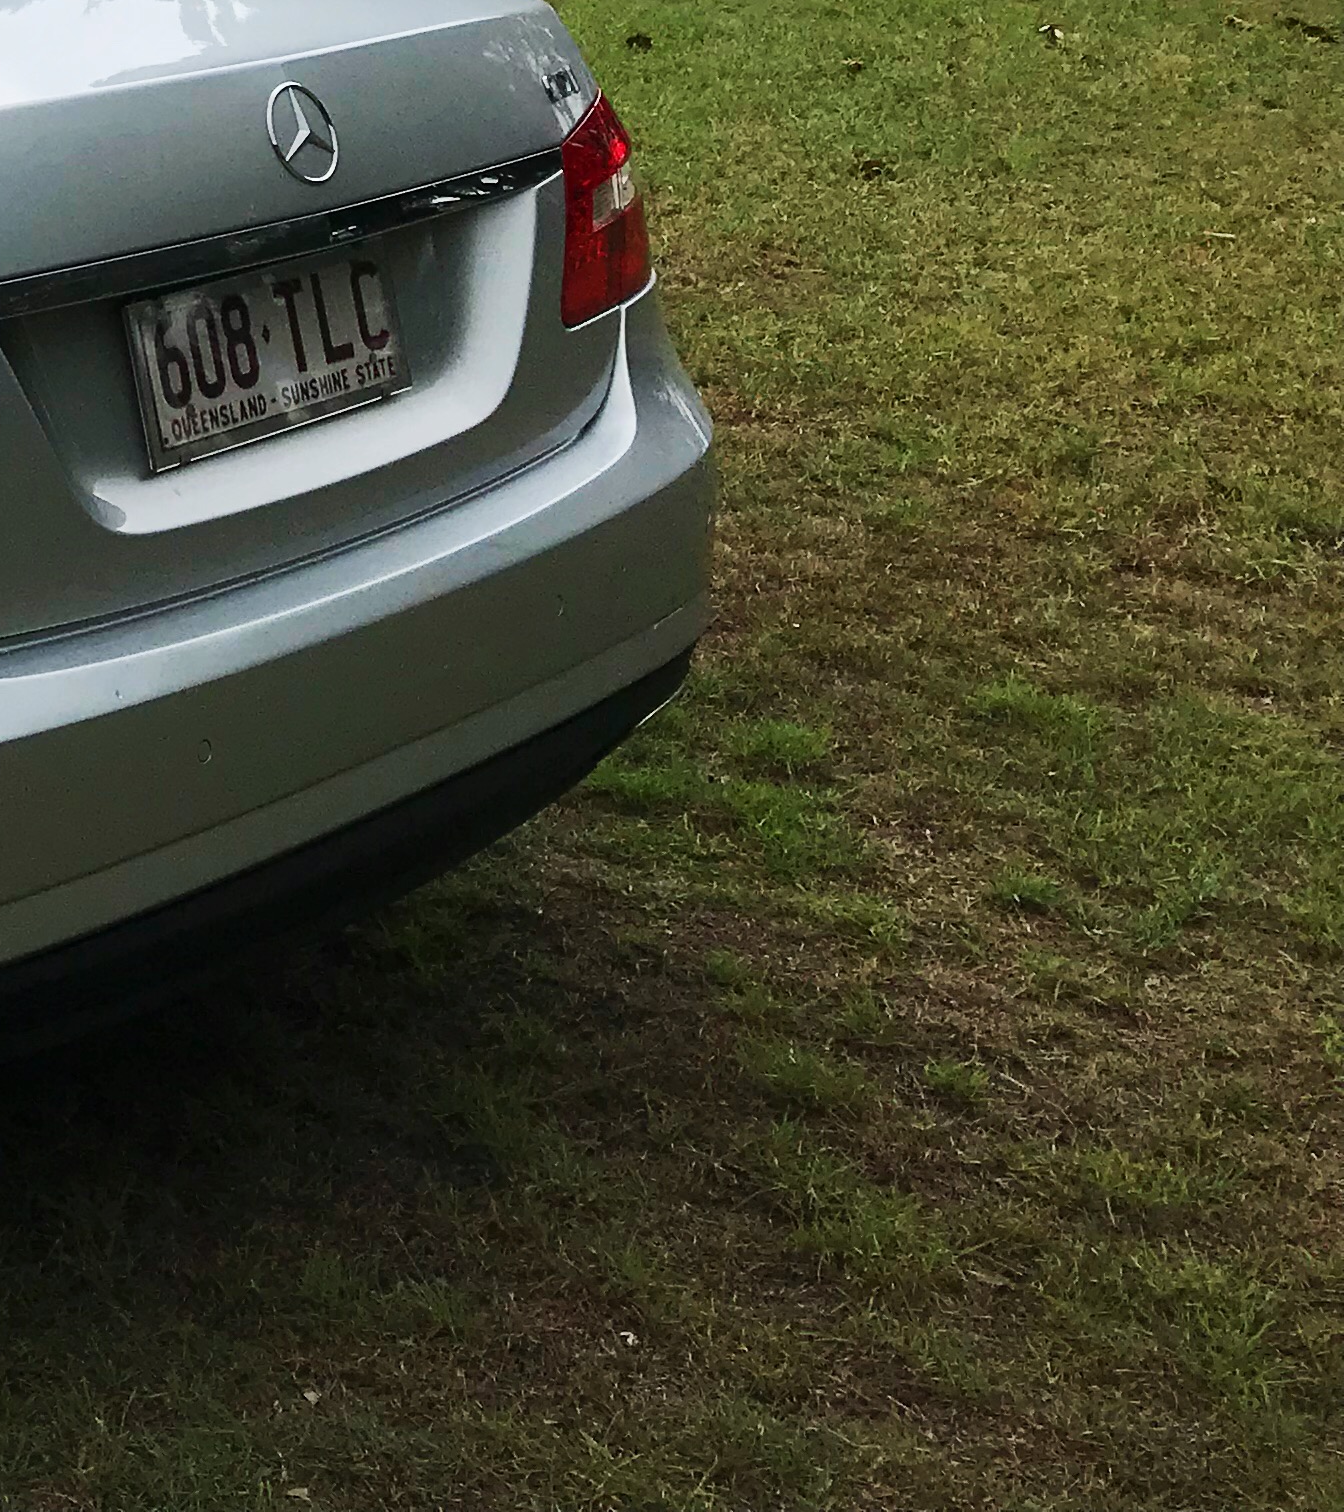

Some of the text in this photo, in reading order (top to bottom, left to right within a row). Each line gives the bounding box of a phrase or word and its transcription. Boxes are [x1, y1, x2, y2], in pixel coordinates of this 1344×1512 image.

[155, 260, 390, 408] 608 TLC
[171, 395, 267, 440] QUEENSLAND
[281, 368, 350, 407] SUNSHINE
[357, 354, 396, 385] STATE
